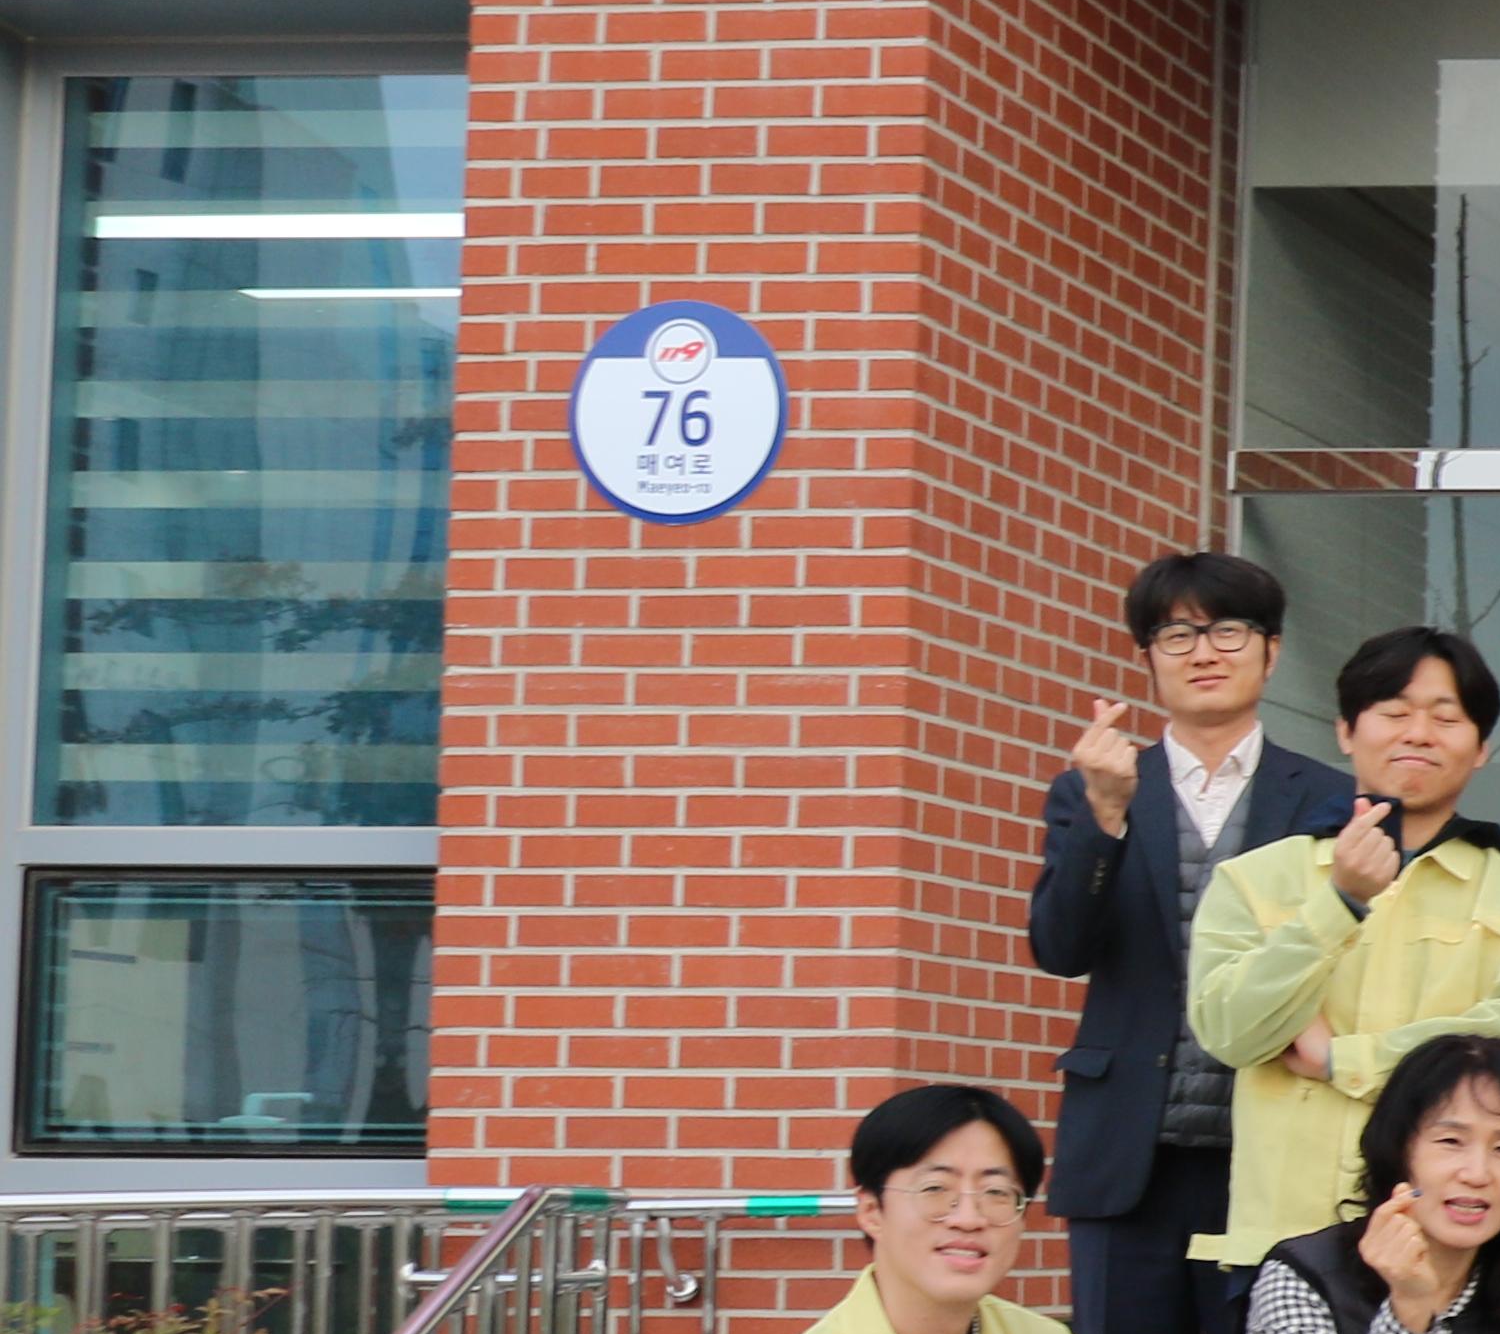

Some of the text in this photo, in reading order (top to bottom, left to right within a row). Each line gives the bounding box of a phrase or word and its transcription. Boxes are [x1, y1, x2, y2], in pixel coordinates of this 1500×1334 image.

[656, 341, 707, 362] 119
[641, 390, 713, 447] 76
[637, 454, 713, 475] 매여로
[637, 480, 712, 496] Maeyeo-ro
